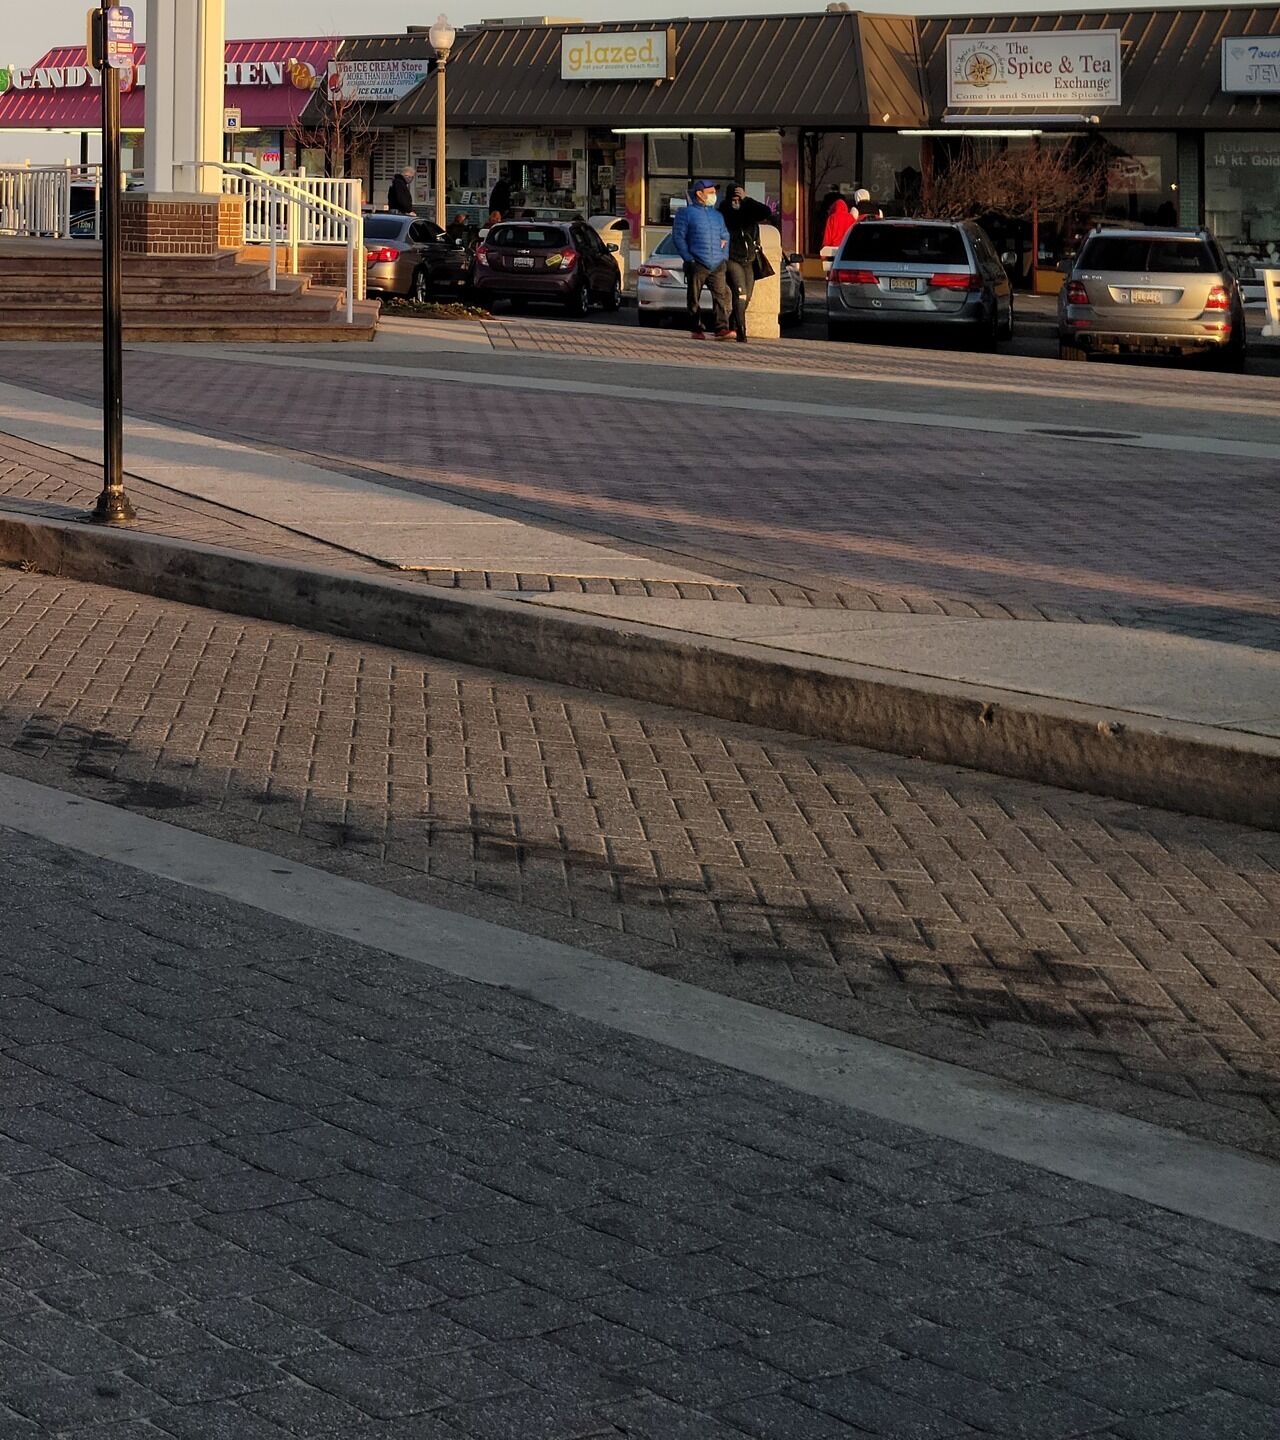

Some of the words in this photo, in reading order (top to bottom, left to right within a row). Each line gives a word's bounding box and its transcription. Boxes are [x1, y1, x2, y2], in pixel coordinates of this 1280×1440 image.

[1006, 42, 1029, 54] The
[354, 63, 368, 72] ICE
[369, 62, 400, 72] CREAM
[401, 62, 423, 71] Store
[1007, 55, 1052, 79] Spice
[1058, 56, 1074, 74] &
[1079, 55, 1111, 73] Tea
[13, 65, 101, 89] CANDY
[347, 72, 363, 80] MORE
[364, 72, 381, 80] THAN
[389, 72, 416, 80] FLAVORS
[1054, 77, 1110, 91] Exchange
[1021, 91, 1048, 99] Smell
[1214, 154, 1226, 166] 14
[1231, 154, 1247, 166] kt.
[1251, 154, 1280, 167] Gold
